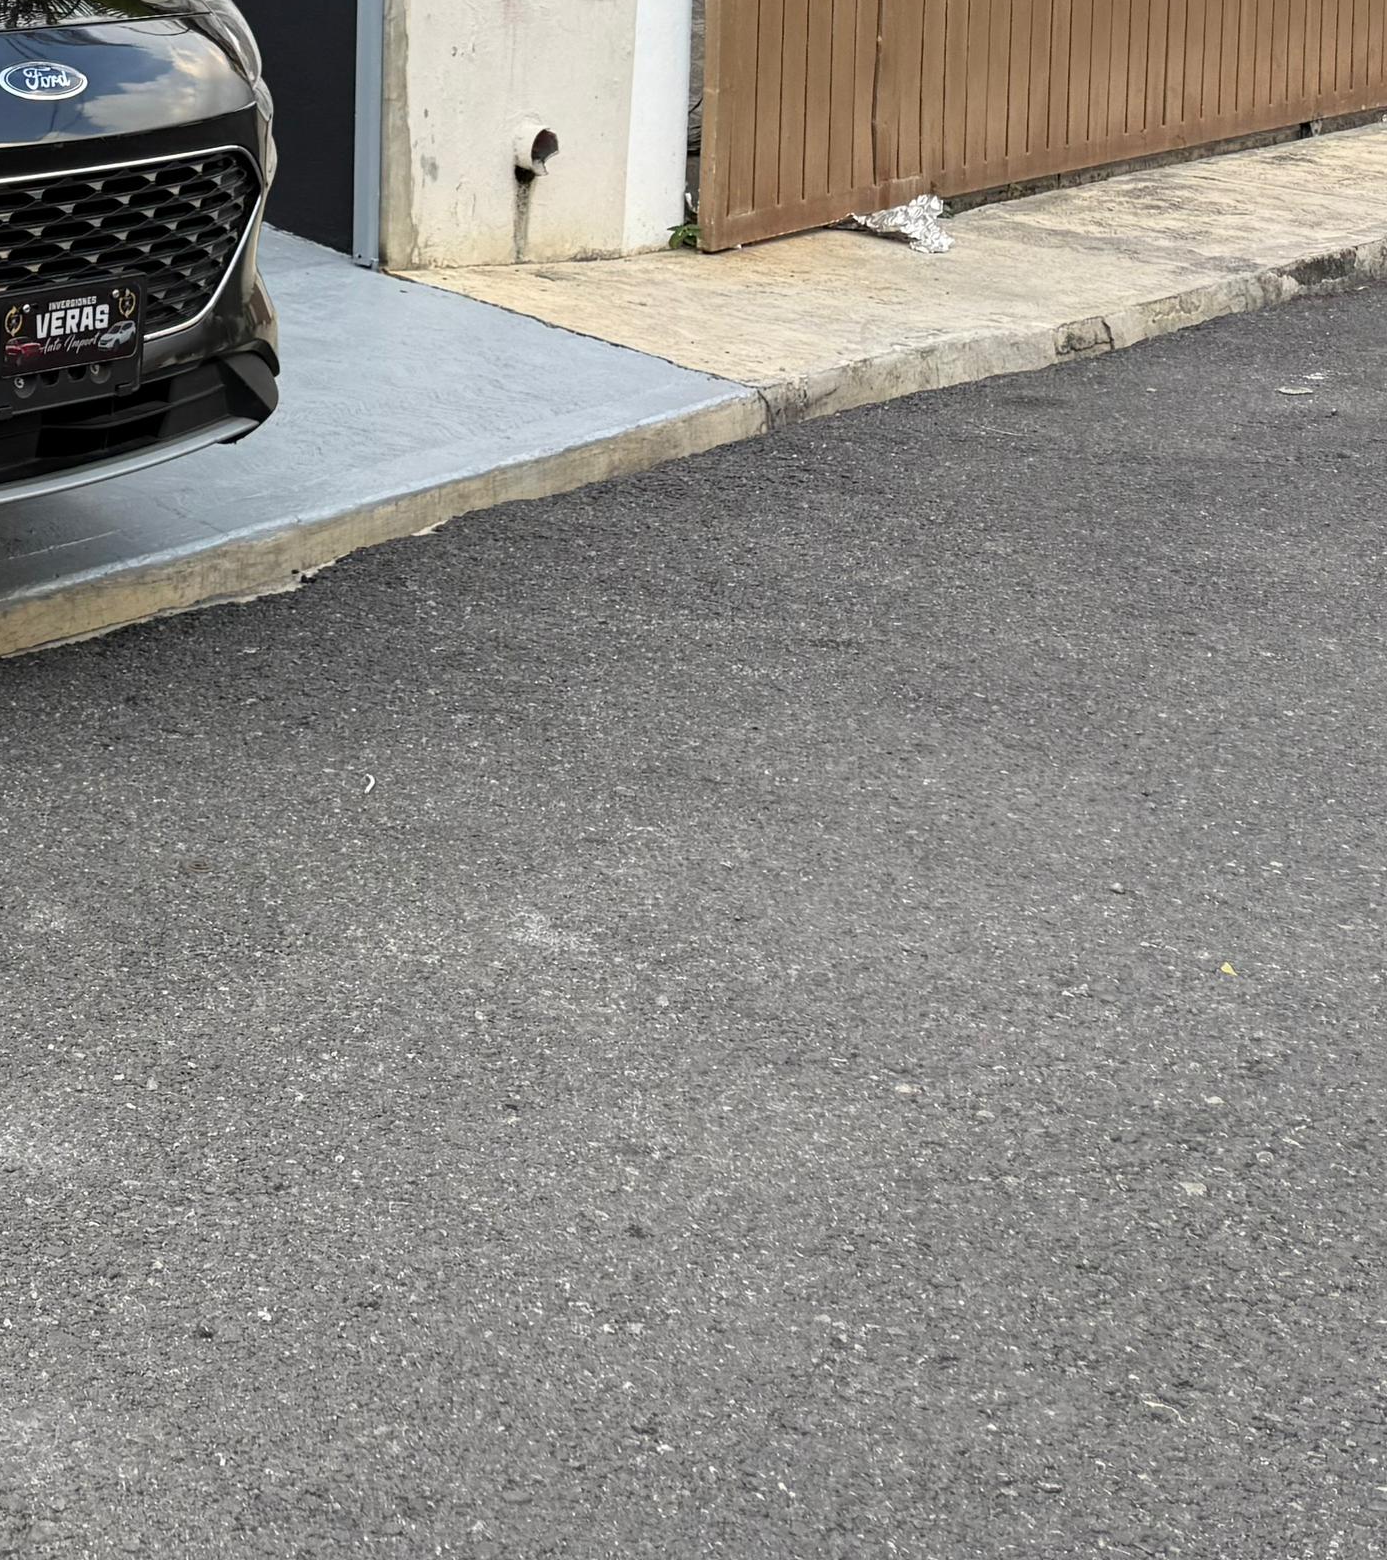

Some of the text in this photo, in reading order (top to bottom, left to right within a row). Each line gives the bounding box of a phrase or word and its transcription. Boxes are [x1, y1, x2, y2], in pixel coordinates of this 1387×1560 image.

[23, 67, 71, 90] Ford
[48, 295, 98, 311] INVERSIONES
[36, 304, 109, 339] VERAS
[39, 331, 101, 355] Auto Import
